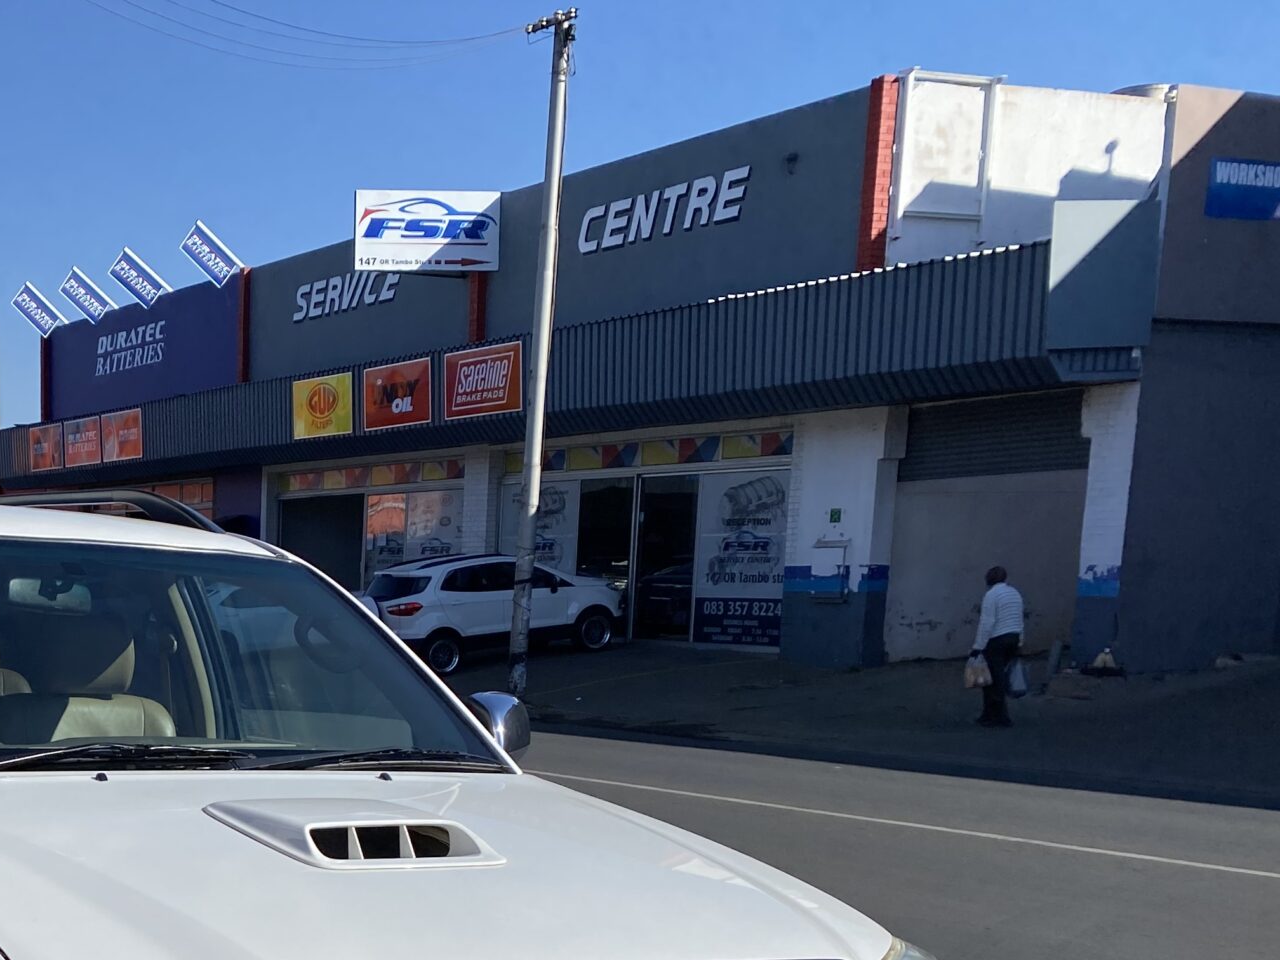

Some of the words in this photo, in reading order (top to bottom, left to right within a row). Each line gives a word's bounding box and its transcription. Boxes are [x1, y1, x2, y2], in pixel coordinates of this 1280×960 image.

[1216, 161, 1280, 188] WORKSHO
[578, 166, 752, 254] CENTRE
[362, 217, 490, 240] FSR
[187, 238, 227, 278] BATTERIES
[192, 234, 231, 274] DURATEC
[359, 257, 377, 266] 147
[114, 264, 156, 300] BATTERIES
[119, 260, 158, 296] DURATEC
[21, 292, 55, 326] DURATEC
[65, 282, 101, 317] BATTERIES
[69, 278, 104, 313] DURATEC
[292, 272, 401, 323] SERVICE
[97, 320, 165, 354] DURATEC
[95, 342, 165, 376] BATTERIES
[392, 396, 413, 414] OIL
[456, 392, 482, 404] BRAKE
[483, 389, 504, 399] PADS
[726, 517, 772, 526] RECEPTION
[421, 546, 451, 555] FSR
[722, 541, 770, 552] FSR
[723, 572, 736, 583] OR
[739, 571, 770, 584] Tambo
[703, 600, 724, 615] 083
[727, 601, 749, 616] 357
[752, 601, 782, 617] 8224
